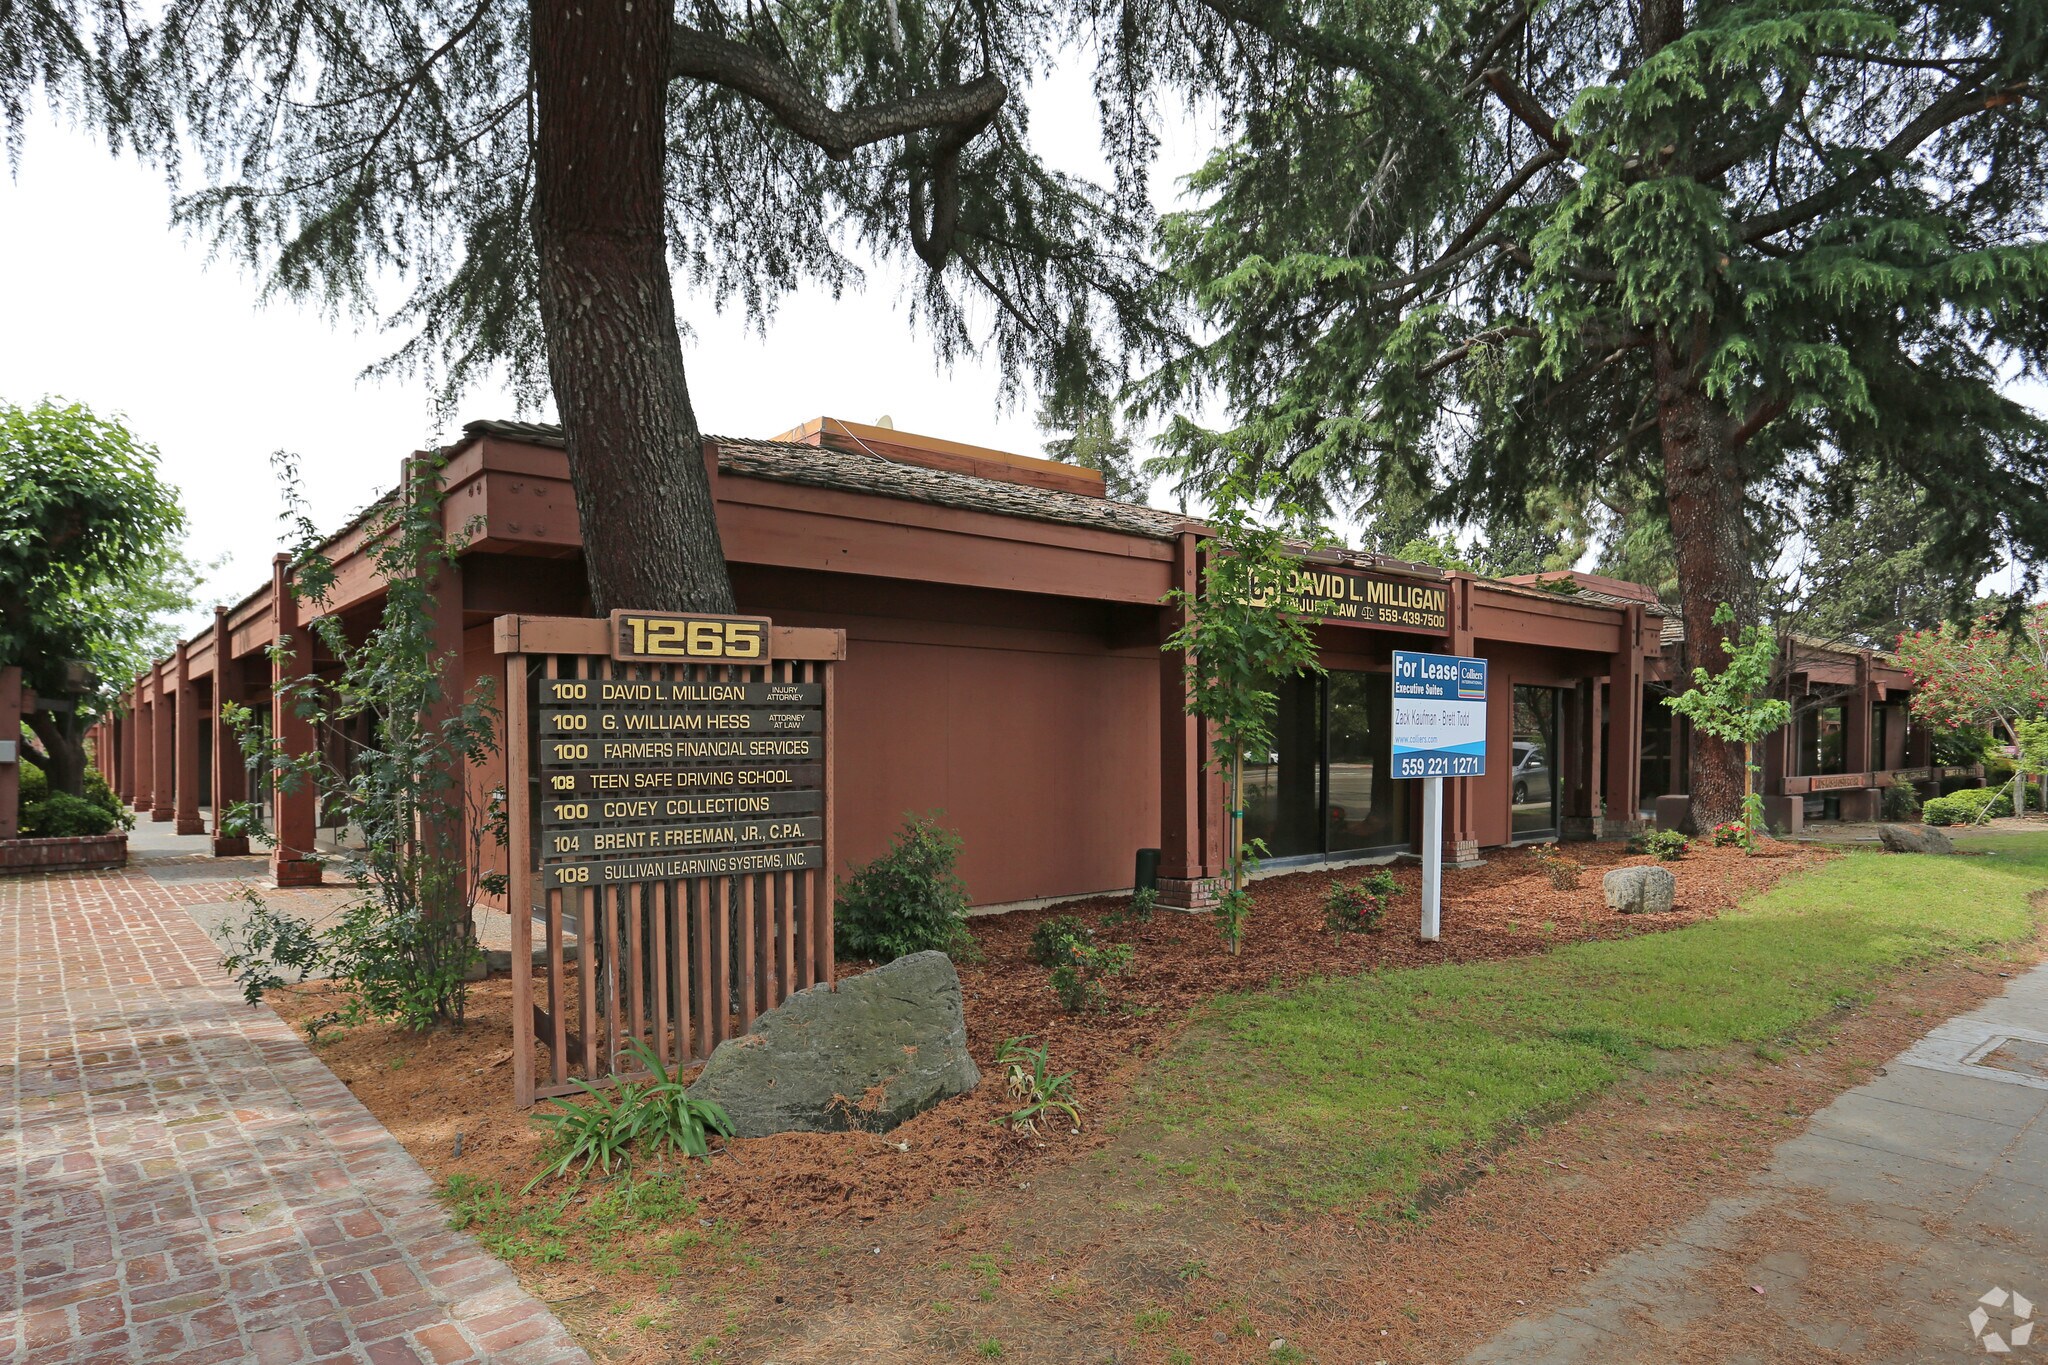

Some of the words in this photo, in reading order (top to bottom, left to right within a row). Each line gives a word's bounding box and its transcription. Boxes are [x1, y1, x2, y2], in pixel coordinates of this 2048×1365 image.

[1287, 571, 1345, 599] DAVID
[1350, 579, 1363, 601] L.
[1367, 581, 1445, 611] MILLIGAN
[627, 618, 761, 657] 1265
[1396, 656, 1417, 678] For
[1422, 658, 1457, 680] Lease
[1462, 668, 1483, 680] Colliers
[552, 684, 587, 699] 100
[602, 684, 651, 701] DAVID
[655, 686, 667, 701] L.
[673, 686, 745, 701] MILLIGAN
[772, 686, 798, 694] INJURY
[1396, 682, 1424, 694] Executive
[1426, 684, 1443, 696] Suites
[552, 714, 587, 729] 100
[602, 714, 619, 729] G.
[625, 714, 702, 729] WILLIAM
[707, 714, 750, 729] HESS
[769, 714, 806, 722] ATTORNEY
[783, 721, 800, 729] LAW
[1396, 709, 1409, 724] Zack
[1412, 710, 1436, 725] Kaufman
[1443, 711, 1456, 726] Brett
[1457, 711, 1470, 726] Todd
[1395, 735, 1438, 743] www.colliers.com
[554, 745, 588, 760] 100
[604, 743, 673, 758] FARMERS
[677, 742, 746, 757] FINANCIAL
[750, 740, 809, 756] SERVICES
[1402, 758, 1424, 775] 559
[1428, 758, 1448, 774] 221
[1453, 758, 1478, 774] 1271
[551, 776, 575, 790] 108
[590, 774, 629, 789] TEEN
[635, 773, 672, 787] SAFE
[677, 772, 733, 786] DRIVING
[738, 770, 792, 784] SCHOOL
[554, 804, 588, 820] 100
[604, 801, 658, 818] COVEY
[666, 797, 770, 815] COLLECTIONS
[554, 836, 579, 851] 104
[594, 833, 644, 850] BRENT
[650, 831, 660, 847] F.
[665, 827, 738, 846] FREEMAN,
[741, 826, 765, 842] JR.,
[769, 824, 804, 839] C.P.A.
[555, 867, 589, 883] 108
[604, 861, 664, 880] SULLIVAN
[667, 858, 726, 875] LEARNING
[729, 854, 783, 873] SYSTEMS,
[785, 853, 807, 867] INC.
